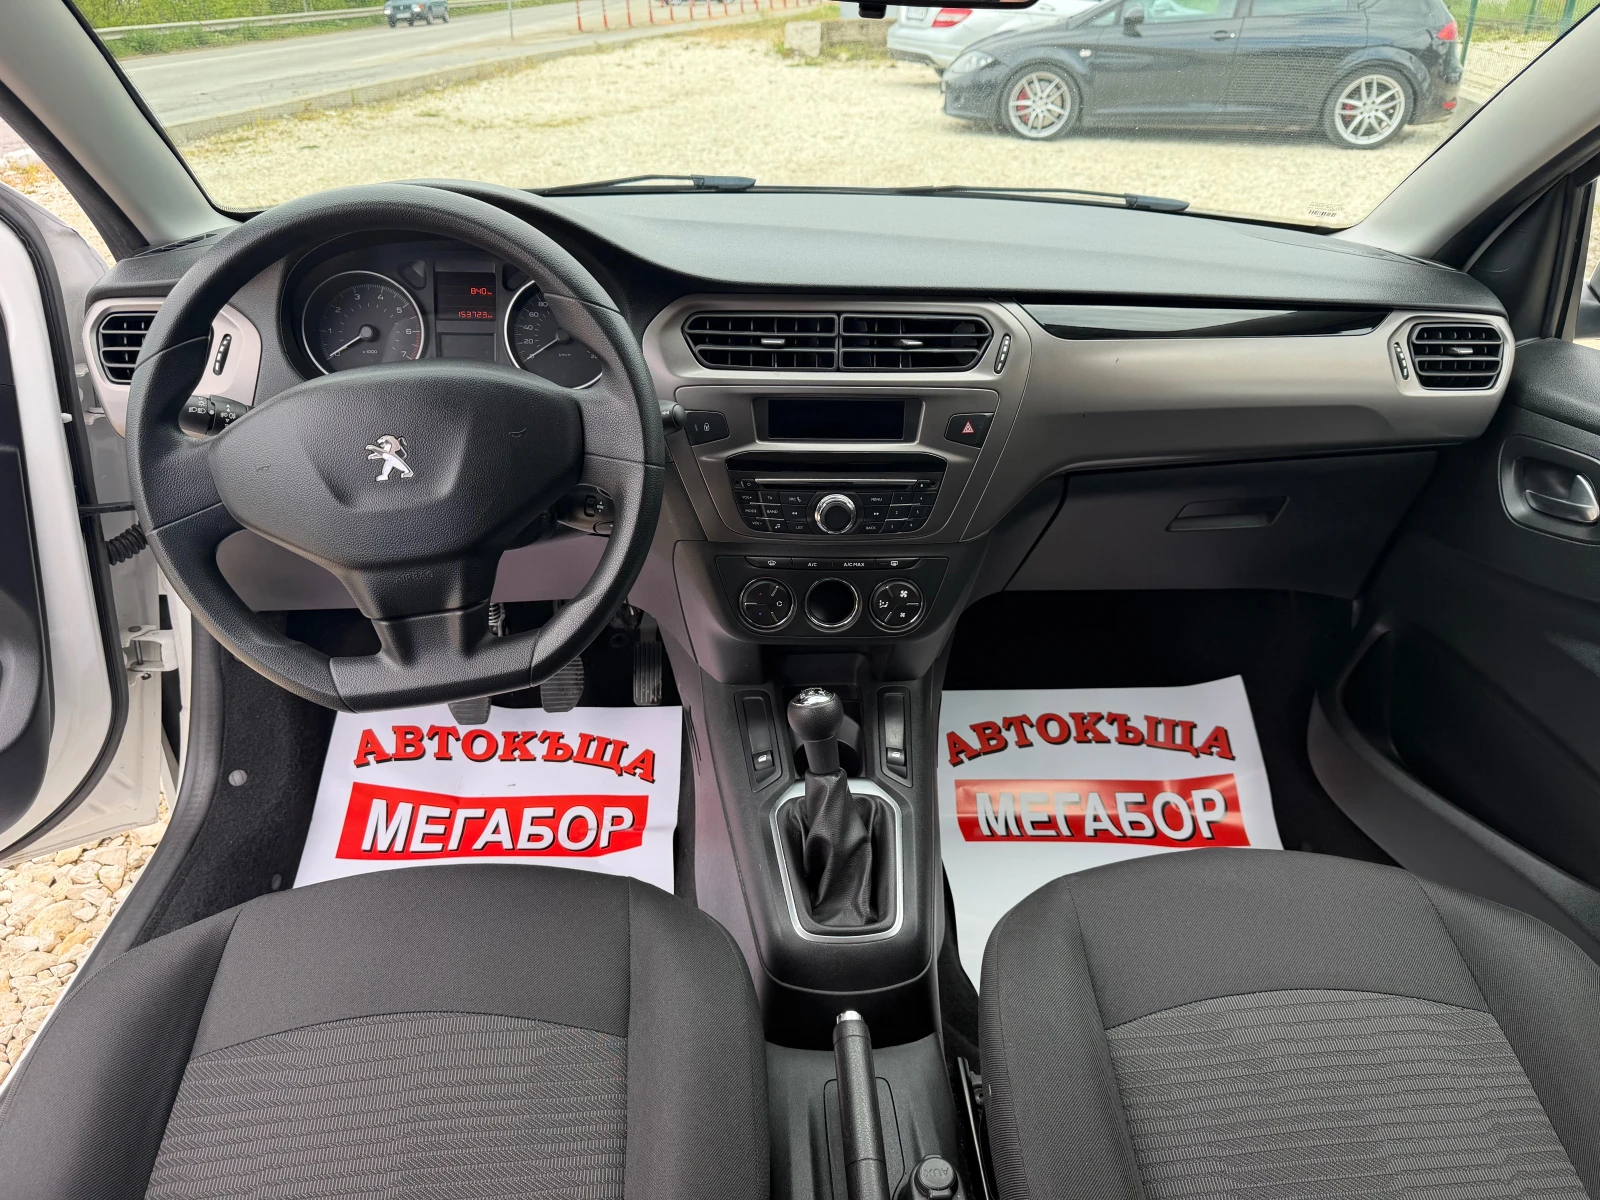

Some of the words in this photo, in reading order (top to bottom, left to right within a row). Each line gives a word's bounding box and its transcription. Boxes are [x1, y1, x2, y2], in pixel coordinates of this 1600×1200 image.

[396, 306, 403, 314] 5
[458, 310, 487, 319] 153723
[353, 725, 655, 783] АВТОКЪЩА
[946, 711, 1236, 768] АВТОКЪЩА
[361, 798, 635, 853] МЕГАБОР
[975, 788, 1228, 841] МЕГАБОР
[924, 1167, 949, 1177] AUX
